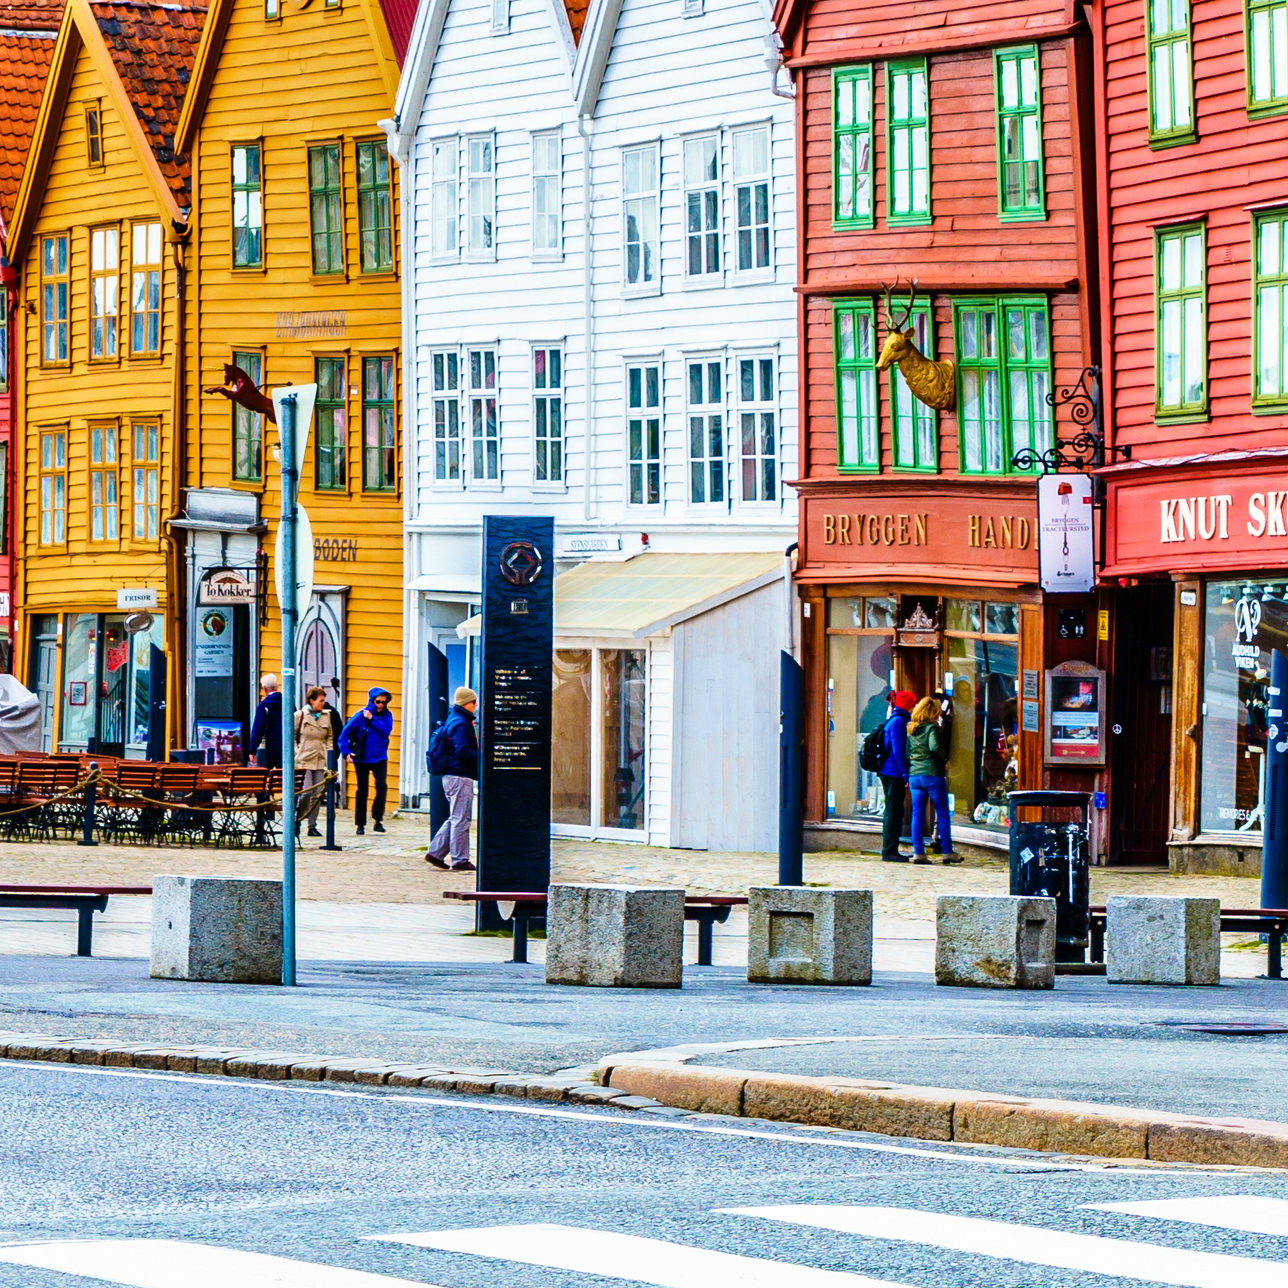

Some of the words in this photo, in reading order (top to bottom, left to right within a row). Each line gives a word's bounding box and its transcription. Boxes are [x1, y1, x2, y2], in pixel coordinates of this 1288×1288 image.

[1160, 495, 1232, 543] KNUT
[823, 513, 929, 547] BRYGGEN
[314, 537, 357, 561] BODEN
[205, 583, 216, 597] To
[217, 583, 252, 597] Kokker
[1232, 643, 1260, 658] AUDHILD
[1235, 657, 1255, 669] VIKEN
